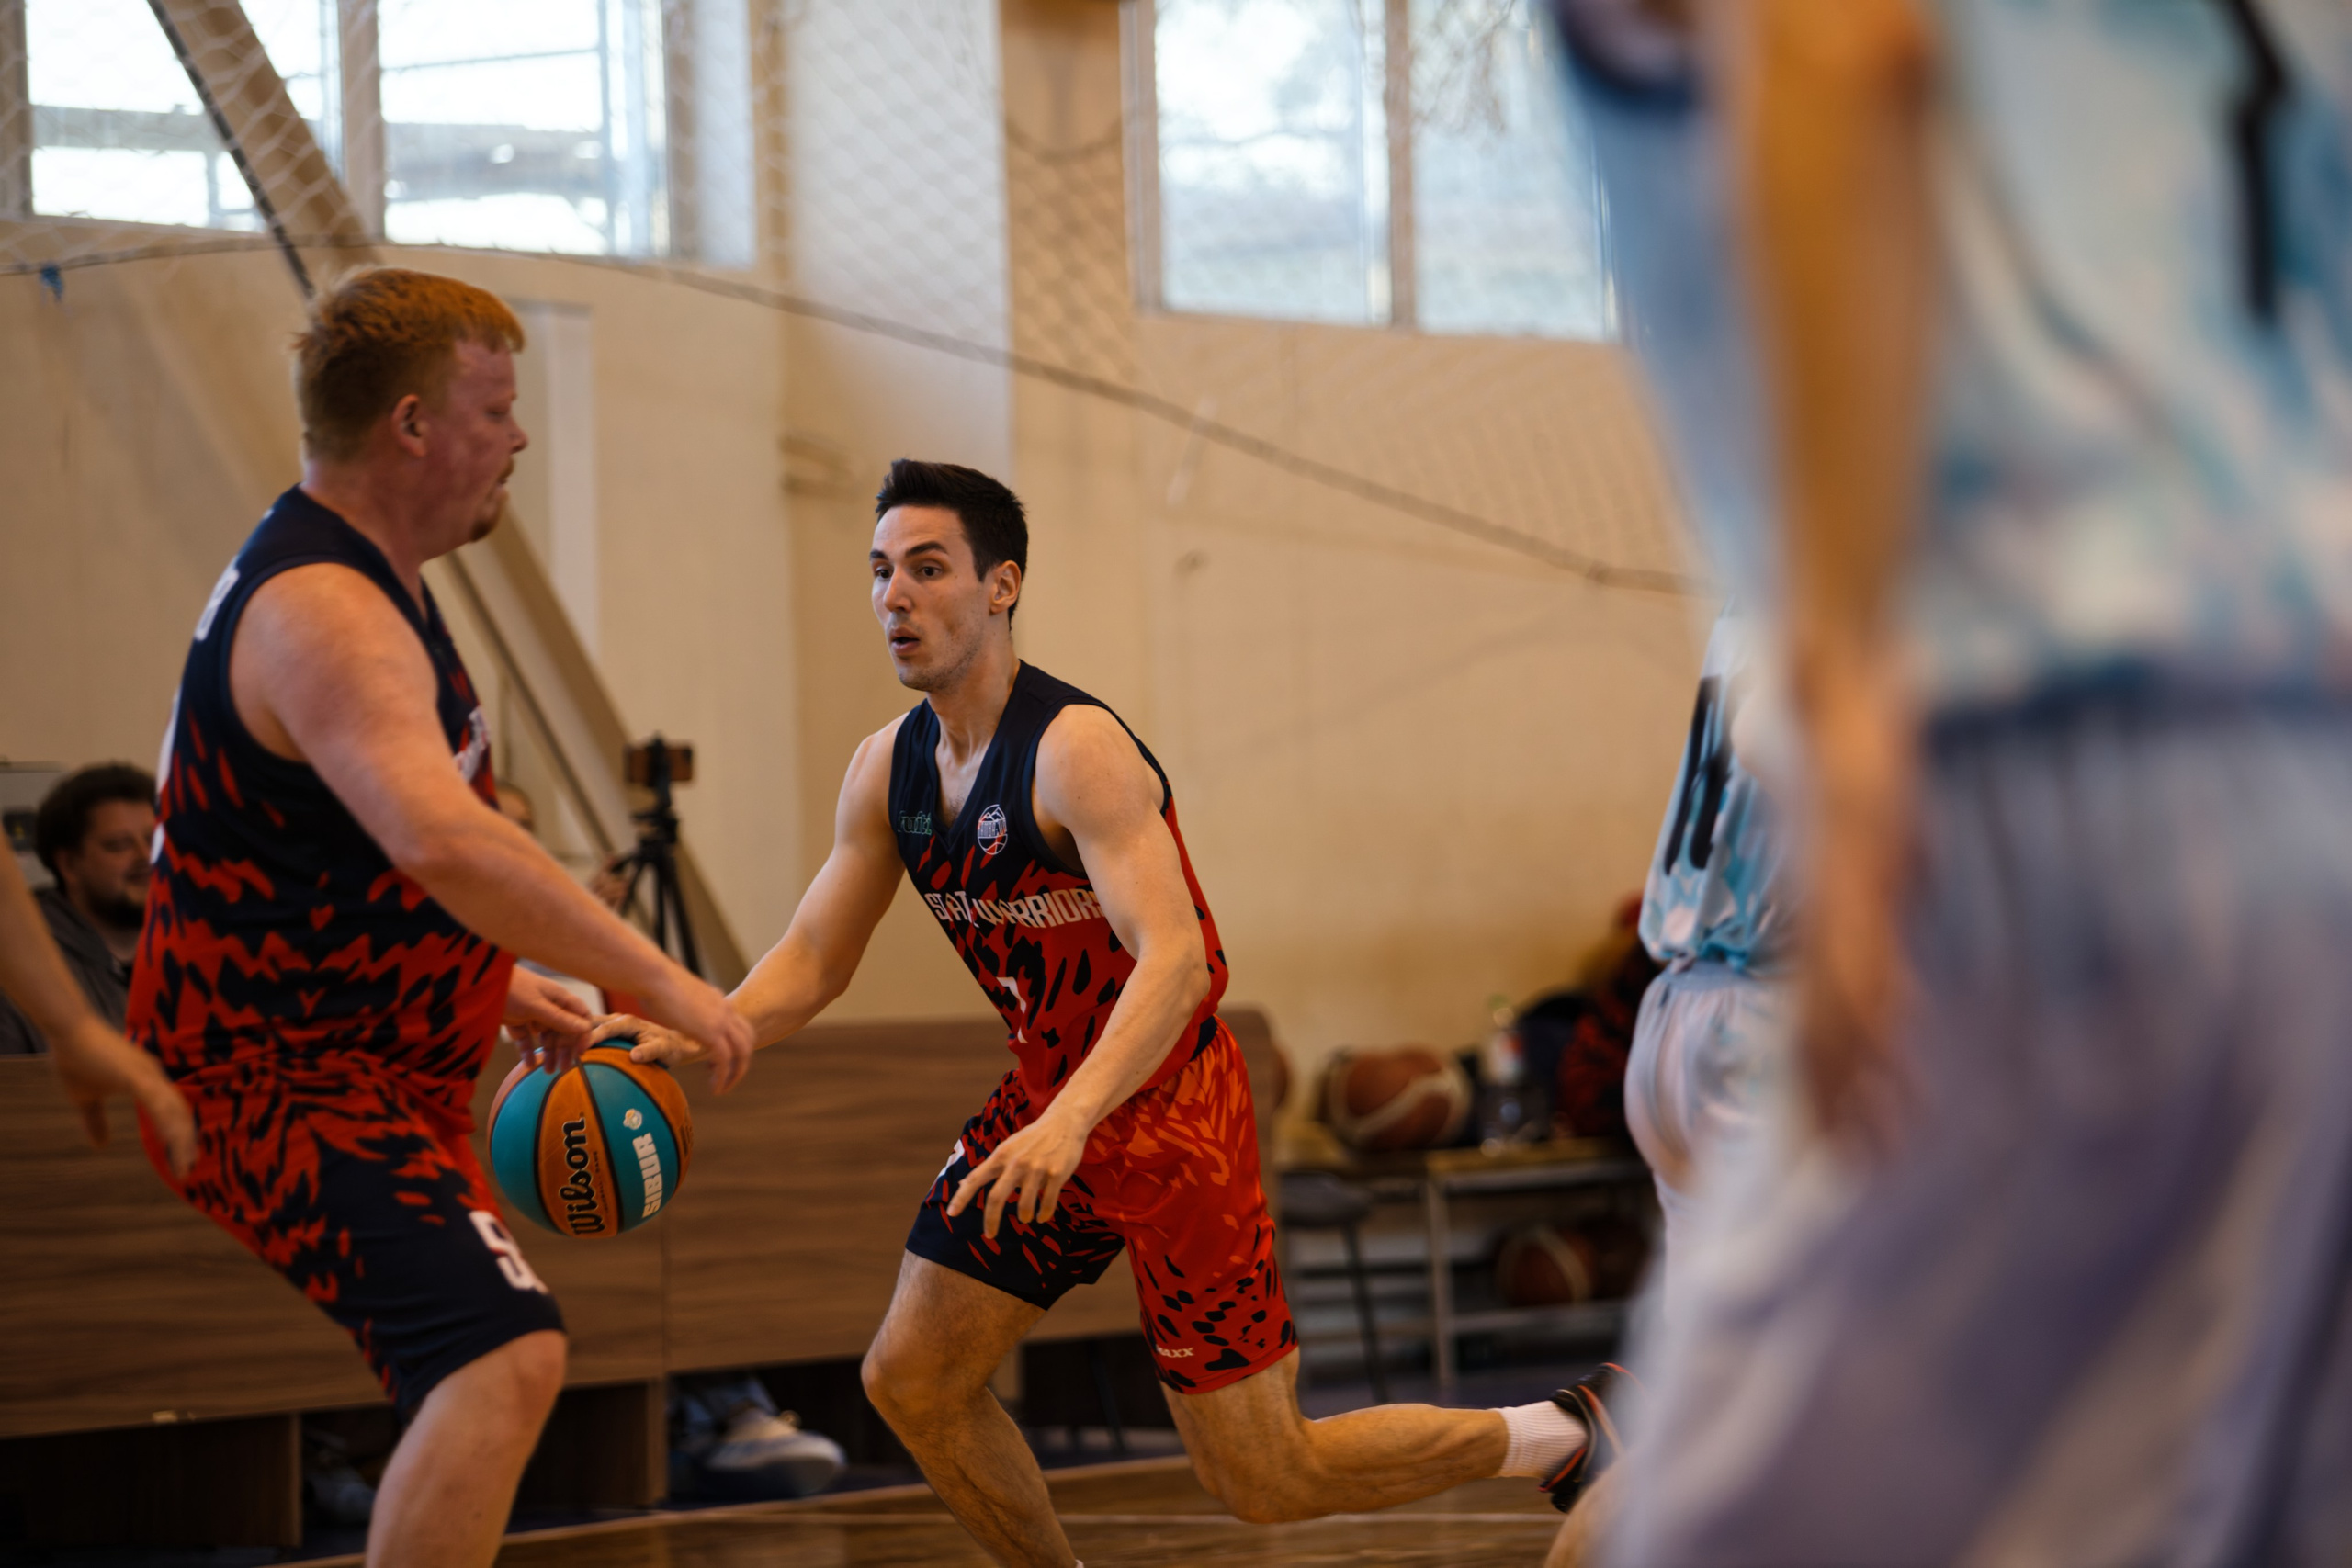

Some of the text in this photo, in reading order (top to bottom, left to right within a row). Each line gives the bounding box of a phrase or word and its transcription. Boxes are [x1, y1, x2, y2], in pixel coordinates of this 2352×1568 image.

[924, 890, 979, 929] STAT
[559, 1117, 605, 1235] Wilson
[632, 1133, 663, 1219] SIBUR
